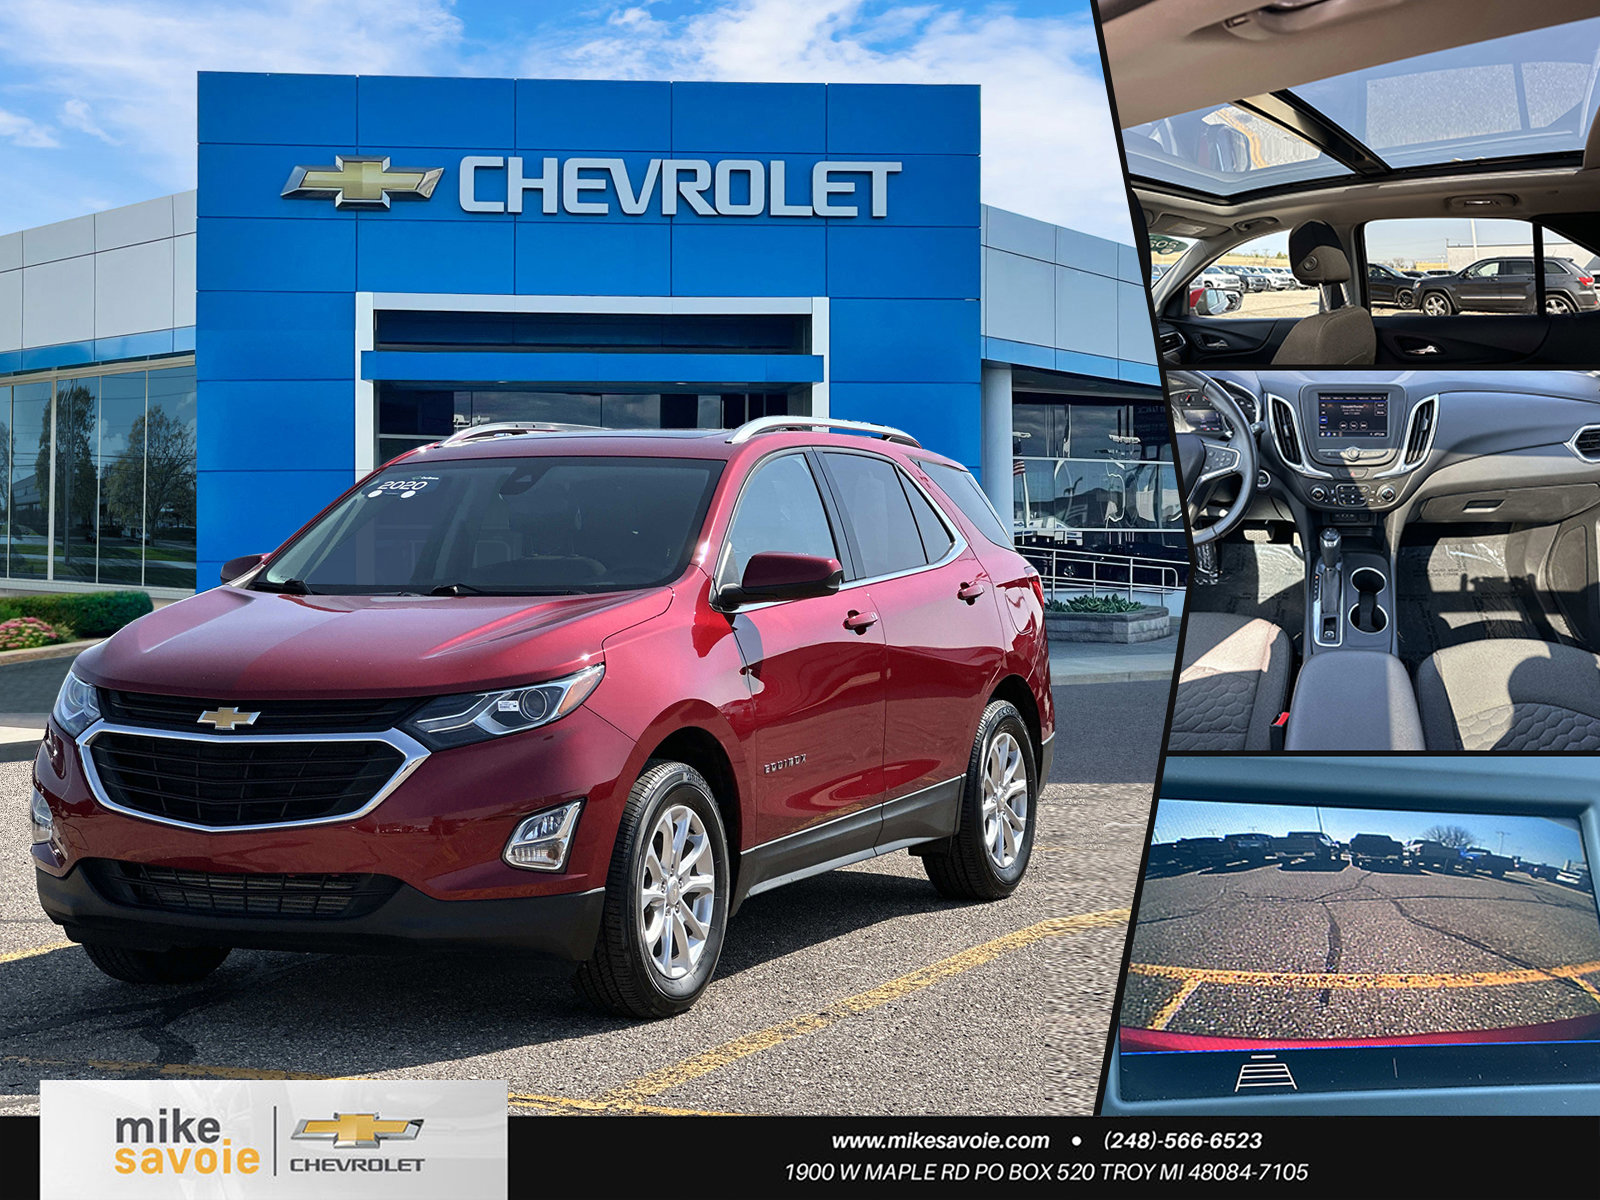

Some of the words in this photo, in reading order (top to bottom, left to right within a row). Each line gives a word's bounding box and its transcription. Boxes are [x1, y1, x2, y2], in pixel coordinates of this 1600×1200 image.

[458, 156, 903, 218] CHEVROLET
[377, 480, 428, 490] 2020
[763, 753, 807, 774] EQUINOX
